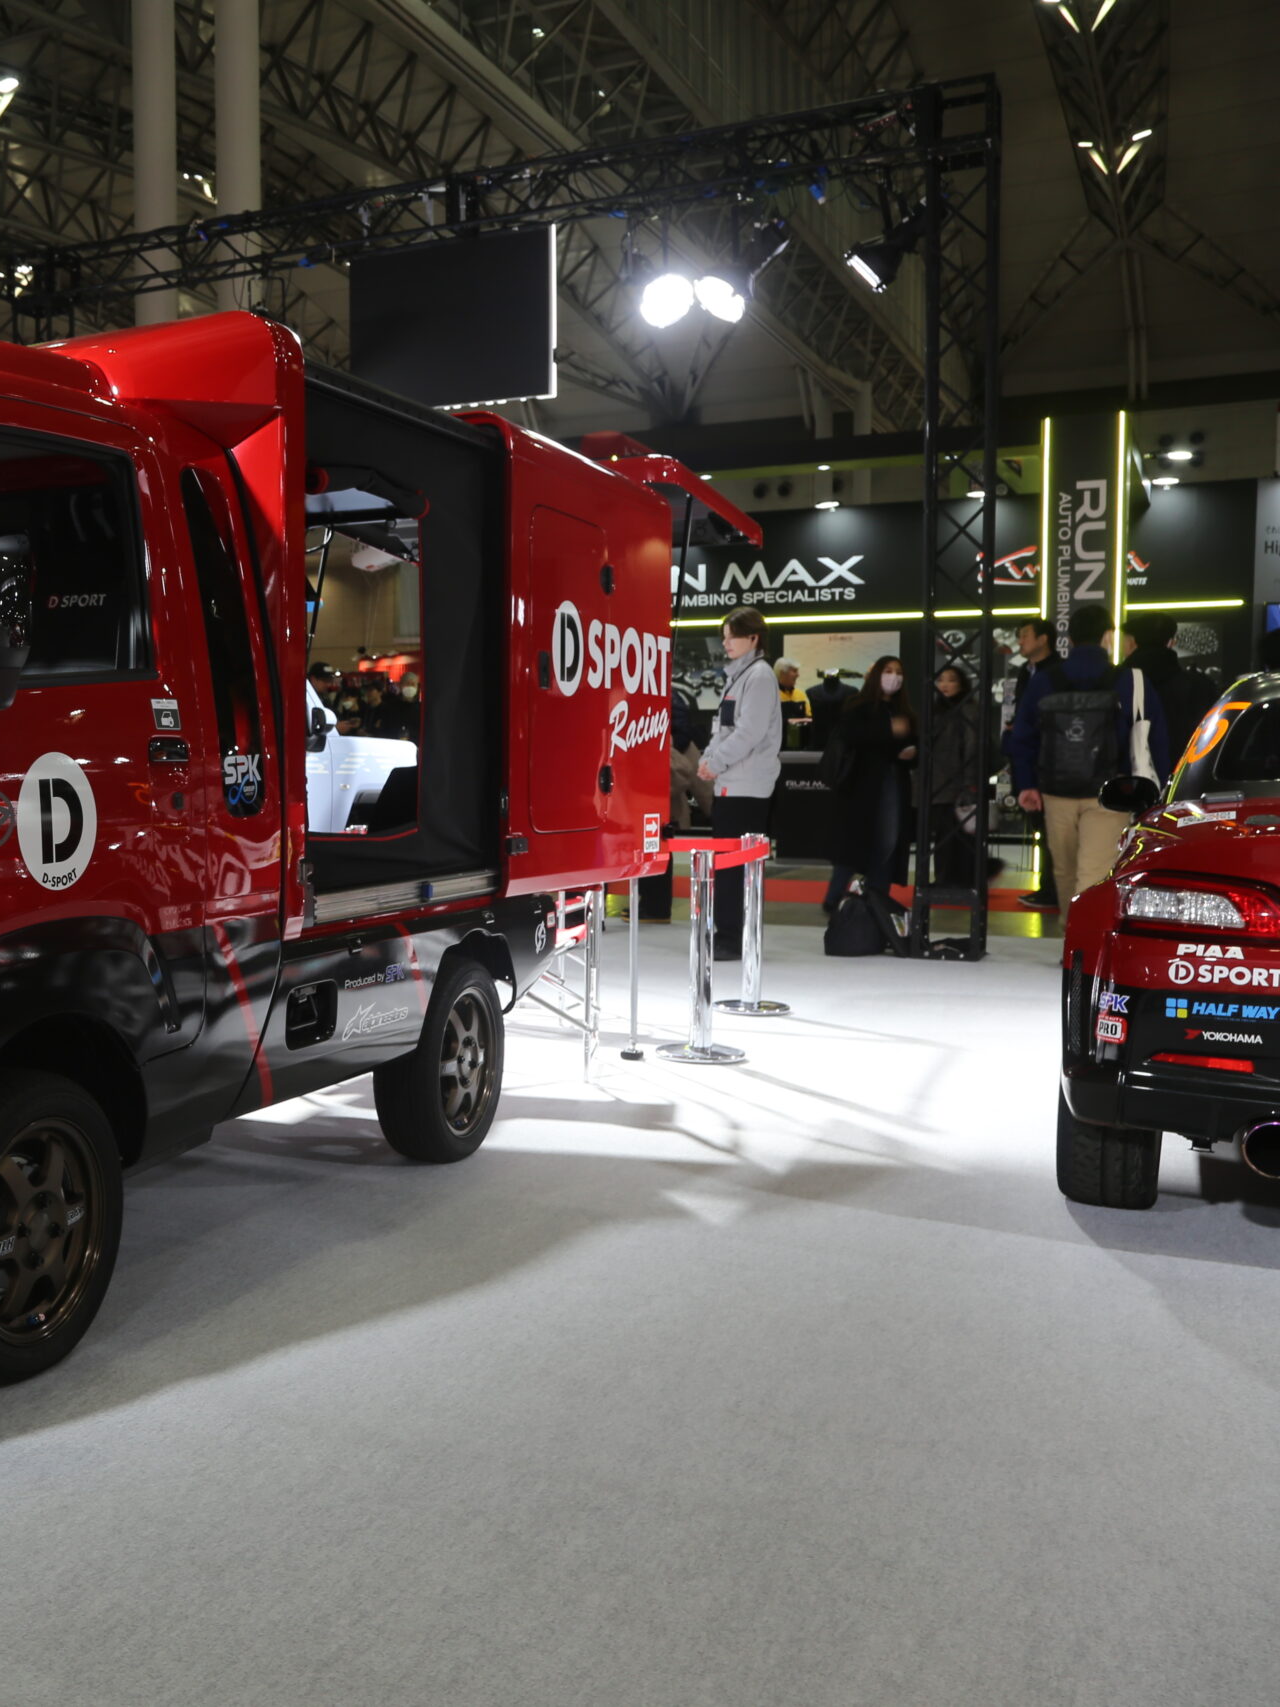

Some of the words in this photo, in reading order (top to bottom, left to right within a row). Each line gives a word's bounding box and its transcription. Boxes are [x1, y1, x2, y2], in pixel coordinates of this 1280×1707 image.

[1058, 491, 1072, 540] AUTO
[1073, 479, 1107, 600] RUN
[1264, 541, 1280, 556] Hi
[720, 555, 866, 591] MAX
[48, 595, 59, 608] D
[60, 593, 107, 608] SPORT
[742, 587, 856, 605] SPECIALISTS
[1056, 546, 1071, 632] PLUMBING
[586, 618, 671, 697] SPORT
[609, 699, 670, 758] Racing
[223, 753, 262, 785] SPK
[38, 777, 84, 864] D
[645, 839, 658, 850] OPEN
[42, 867, 78, 888] D-SPORT
[1176, 943, 1245, 960] PIAA
[344, 974, 376, 990] Produced
[376, 972, 385, 983] by
[385, 962, 405, 983] SPK
[1197, 964, 1280, 988] SPORT
[1098, 991, 1130, 1014] SPK
[1192, 1001, 1240, 1017] HALF
[1242, 1004, 1280, 1020] WAY
[1099, 1021, 1118, 1037] PRO
[1201, 1031, 1264, 1044] YOKOHAMA
